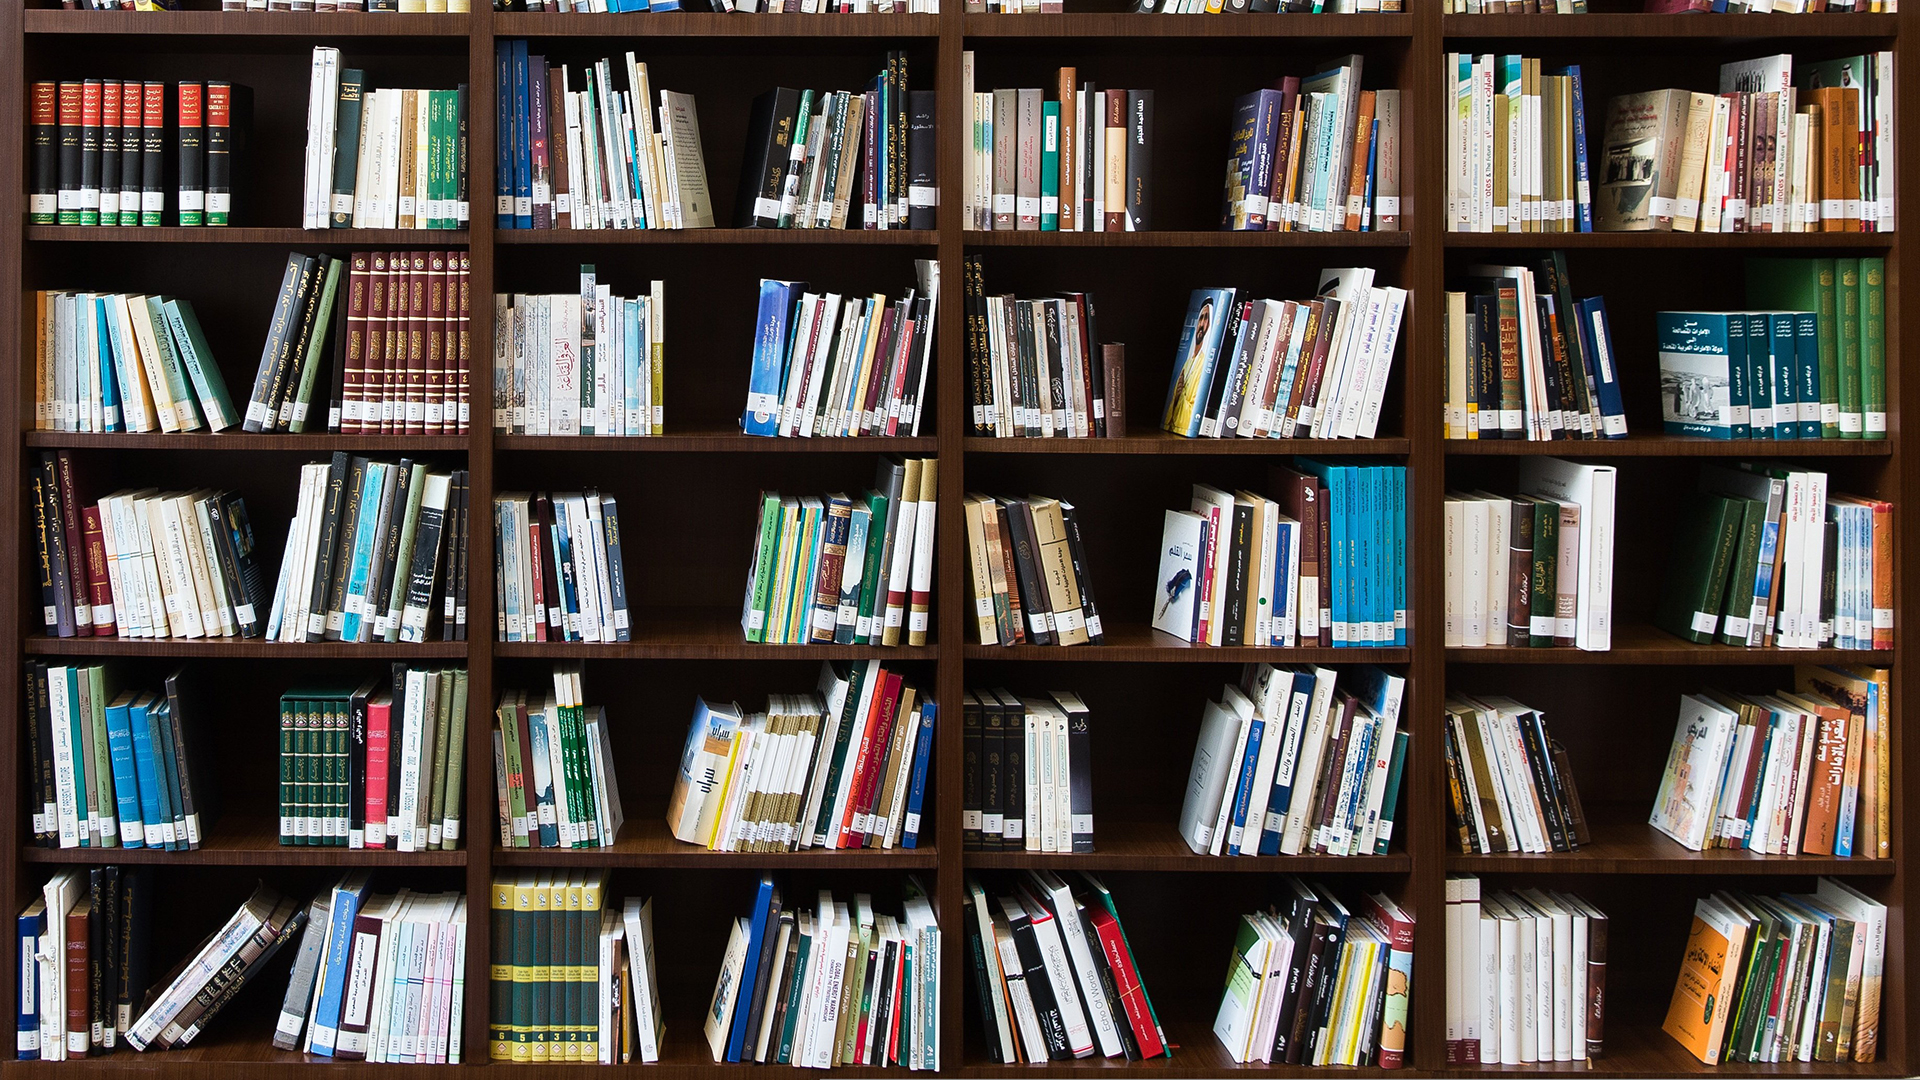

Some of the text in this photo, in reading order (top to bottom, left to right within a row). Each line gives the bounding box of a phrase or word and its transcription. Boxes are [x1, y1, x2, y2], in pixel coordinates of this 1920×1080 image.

[1136, 100, 1144, 109] خلف
[1136, 124, 1144, 144] الحبتور
[969, 315, 978, 332] الشيخ
[978, 315, 988, 332] الشيخ
[263, 295, 290, 375] الإمارات العربية
[970, 333, 978, 352] سلطان
[980, 333, 988, 353] سلطان
[330, 479, 342, 515] زايد
[345, 500, 357, 539] الإمارات
[338, 543, 350, 582] العربية
[882, 697, 892, 721] النخيل
[1290, 699, 1304, 717] راشد
[1283, 727, 1298, 756] المسيرة
[1815, 719, 1830, 761] موسوعة
[857, 736, 872, 775] الشيخ سلطان
[870, 744, 883, 765] التمور
[1829, 747, 1844, 785] الإمارات
[829, 981, 840, 999] ENERGY
[828, 1000, 836, 1021] MARKETS
[1087, 970, 1111, 1032] Echo Of Words
[499, 1032, 505, 1040] 6
[520, 1034, 526, 1042] 5
[538, 1033, 544, 1041] 4
[554, 1033, 560, 1041] 3
[570, 1033, 576, 1041] 2
[586, 1033, 592, 1041] 1
[1050, 1009, 1065, 1050] ميزان العدالة
